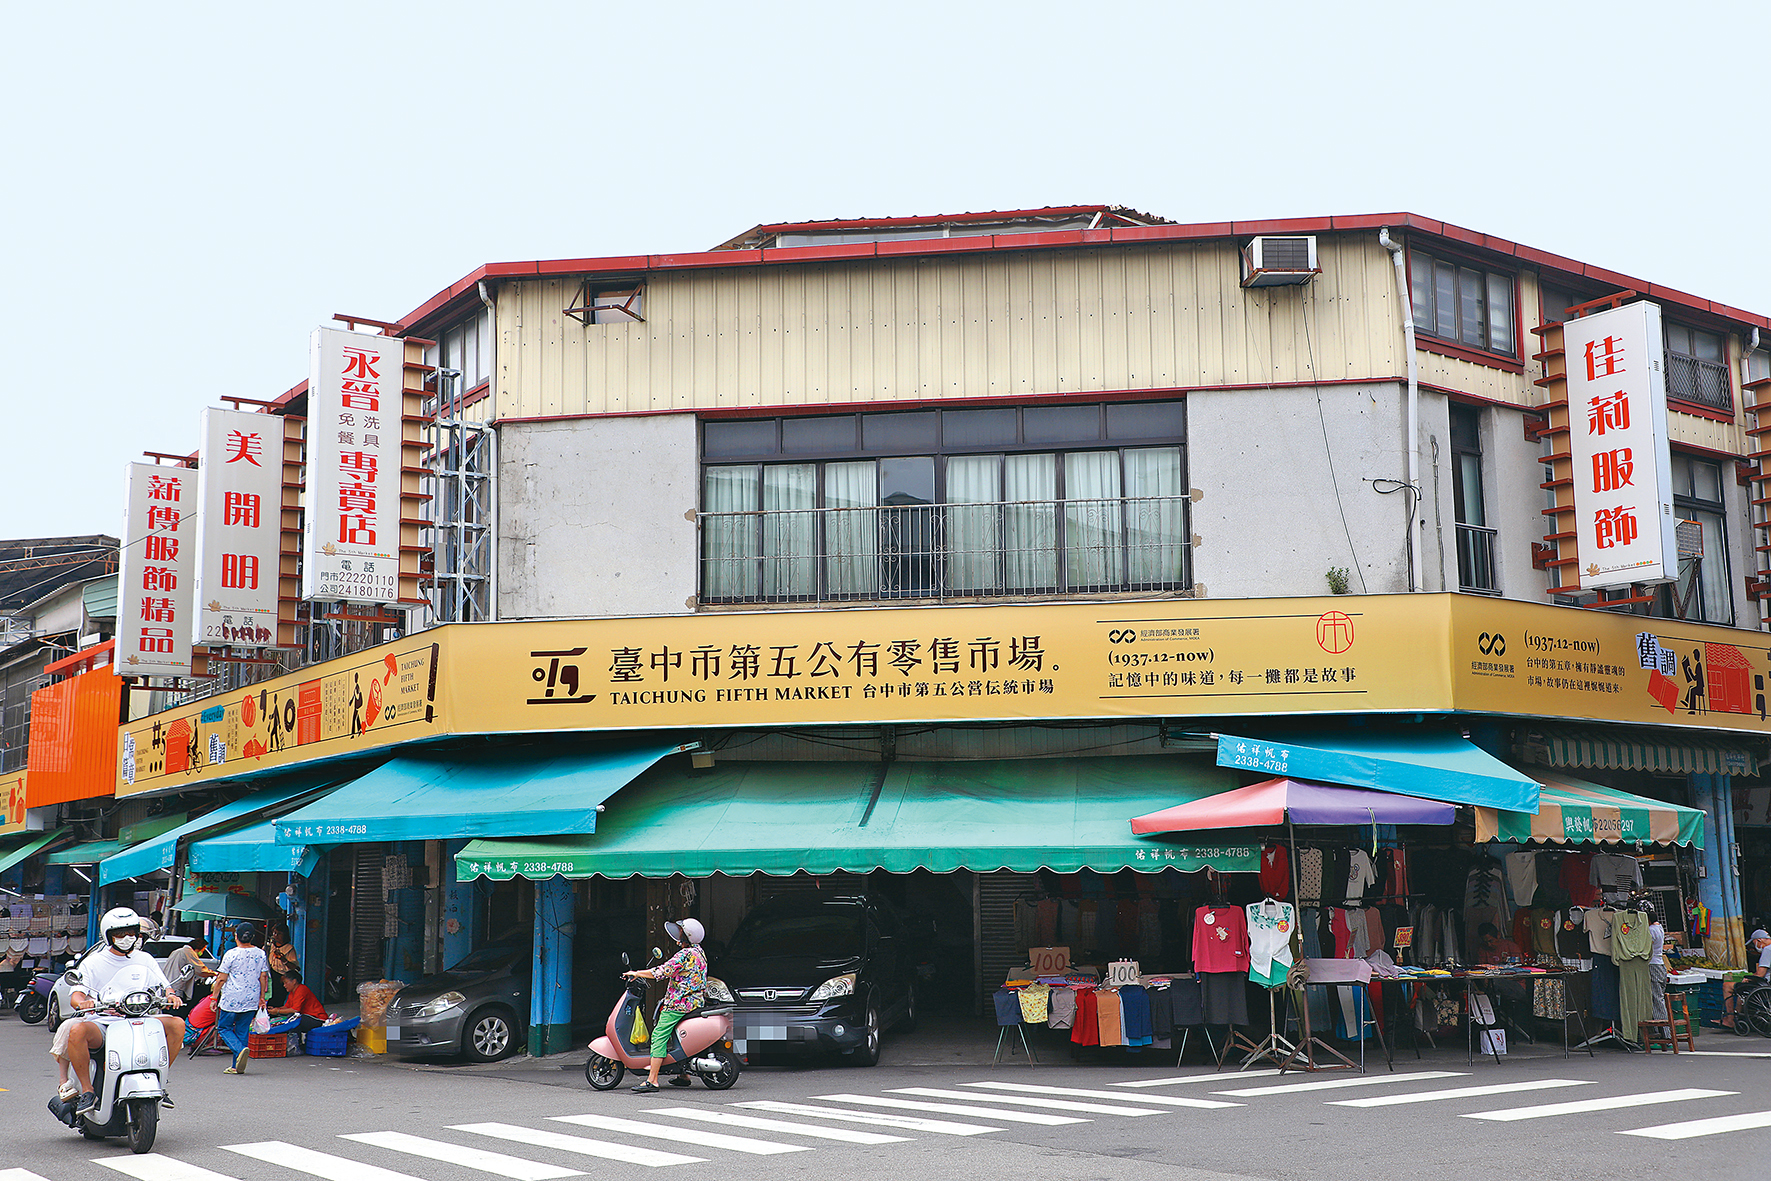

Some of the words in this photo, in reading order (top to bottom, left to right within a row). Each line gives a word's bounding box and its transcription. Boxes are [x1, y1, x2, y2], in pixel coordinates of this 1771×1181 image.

[341, 346, 381, 412] 永晉
[338, 412, 380, 429] 免洗
[1583, 335, 1638, 550] 佳莉服飾
[337, 450, 378, 546] 專賣店
[221, 429, 263, 591] 美開明
[139, 475, 182, 654] 薪傳服飾精品
[341, 560, 375, 573] 電話
[1524, 630, 1600, 656] (1937.12-now)
[608, 635, 1061, 682] 臺中市第五公有零售市場。
[1108, 647, 1214, 667] (1937.12-now)
[1108, 667, 1357, 688] 記憶中的味道，每一攤都是故事
[610, 689, 707, 706] TAICHUNG
[716, 687, 768, 702] FIFTH
[775, 685, 852, 701] MARKET
[1235, 742, 1290, 761] 佑祥帆布
[1234, 755, 1288, 773] 2338-4788
[326, 825, 367, 835] 2338-4788
[469, 861, 519, 873] 佑祥帆布
[524, 862, 574, 872] 2338-4788
[1034, 953, 1066, 972] 100
[1112, 966, 1137, 983] 100
